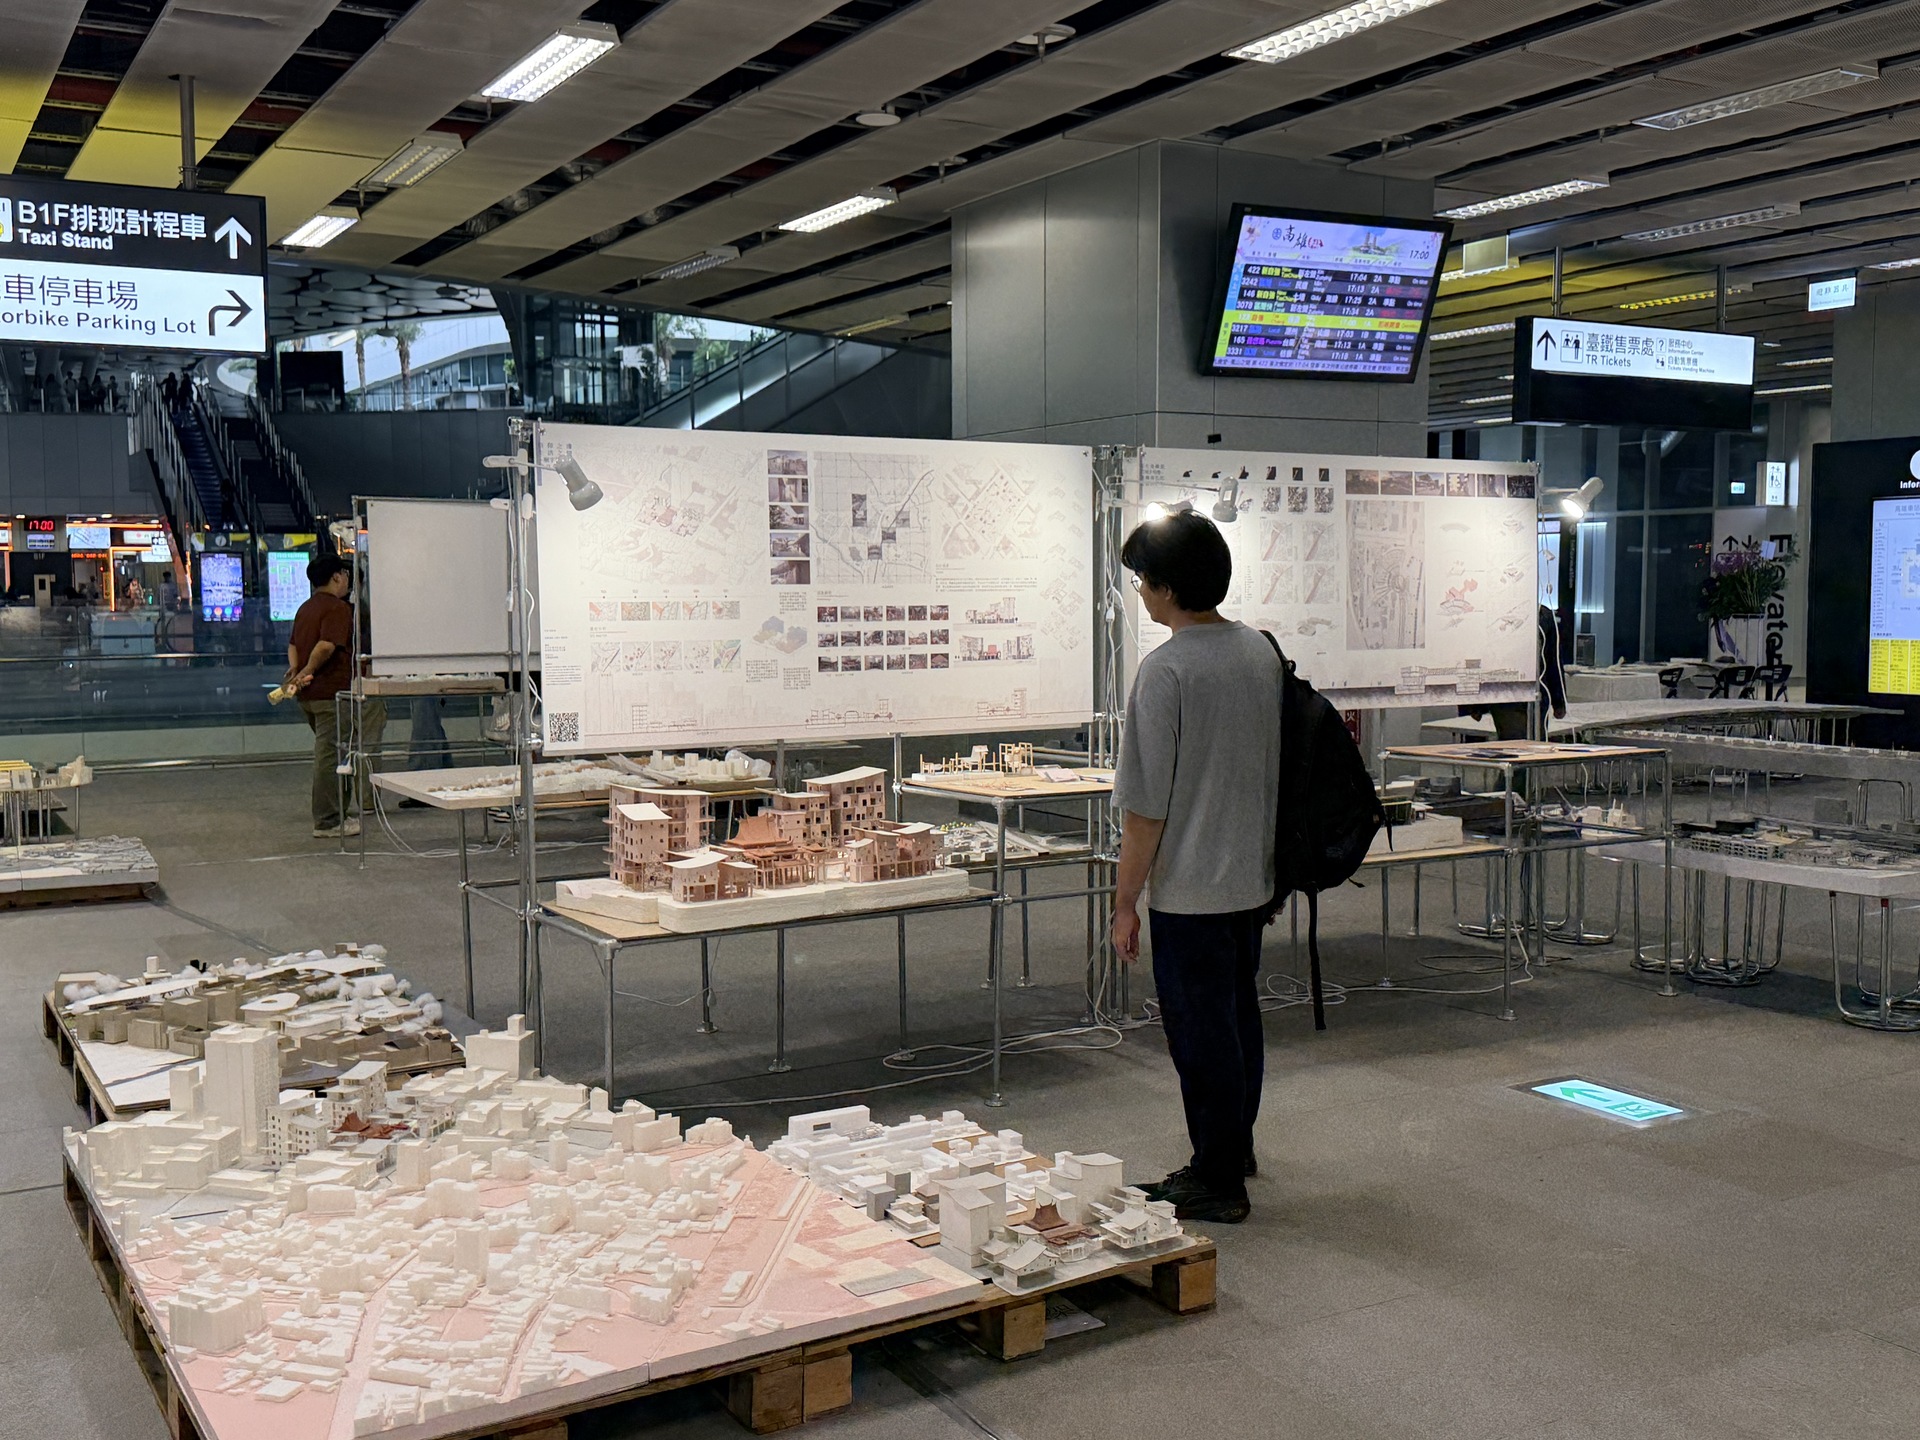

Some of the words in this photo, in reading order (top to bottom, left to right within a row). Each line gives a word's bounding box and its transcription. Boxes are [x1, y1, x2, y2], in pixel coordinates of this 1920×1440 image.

[18, 200, 207, 241] B1F排班計程車
[18, 228, 57, 246] Taxi
[61, 231, 114, 250] Stand
[1409, 250, 1430, 260] 17:00
[1247, 266, 1260, 274] 422
[1350, 273, 1367, 281] 17:04
[1373, 275, 1382, 283] 2A
[0, 274, 138, 311] 車停車場
[1241, 277, 1258, 286] 3242
[1347, 284, 1365, 293] 17:13
[1371, 286, 1380, 294] 2A
[1367, 297, 1377, 306] 2A
[1342, 307, 1360, 316] 17:34
[1365, 309, 1375, 317] 2A
[0, 309, 69, 327] orbike
[77, 312, 156, 335] Parking
[164, 317, 196, 334] Lot
[1231, 324, 1248, 332] 3217
[1336, 330, 1354, 338] 17:03
[1334, 341, 1351, 349] 17:13
[1358, 342, 1366, 350] 1A
[1586, 332, 1655, 357] 臺鐵售票處
[1355, 353, 1364, 361] 1A
[1586, 354, 1598, 365] TR
[1600, 355, 1632, 367] Tickets
[1900, 480, 1920, 489] Infor
